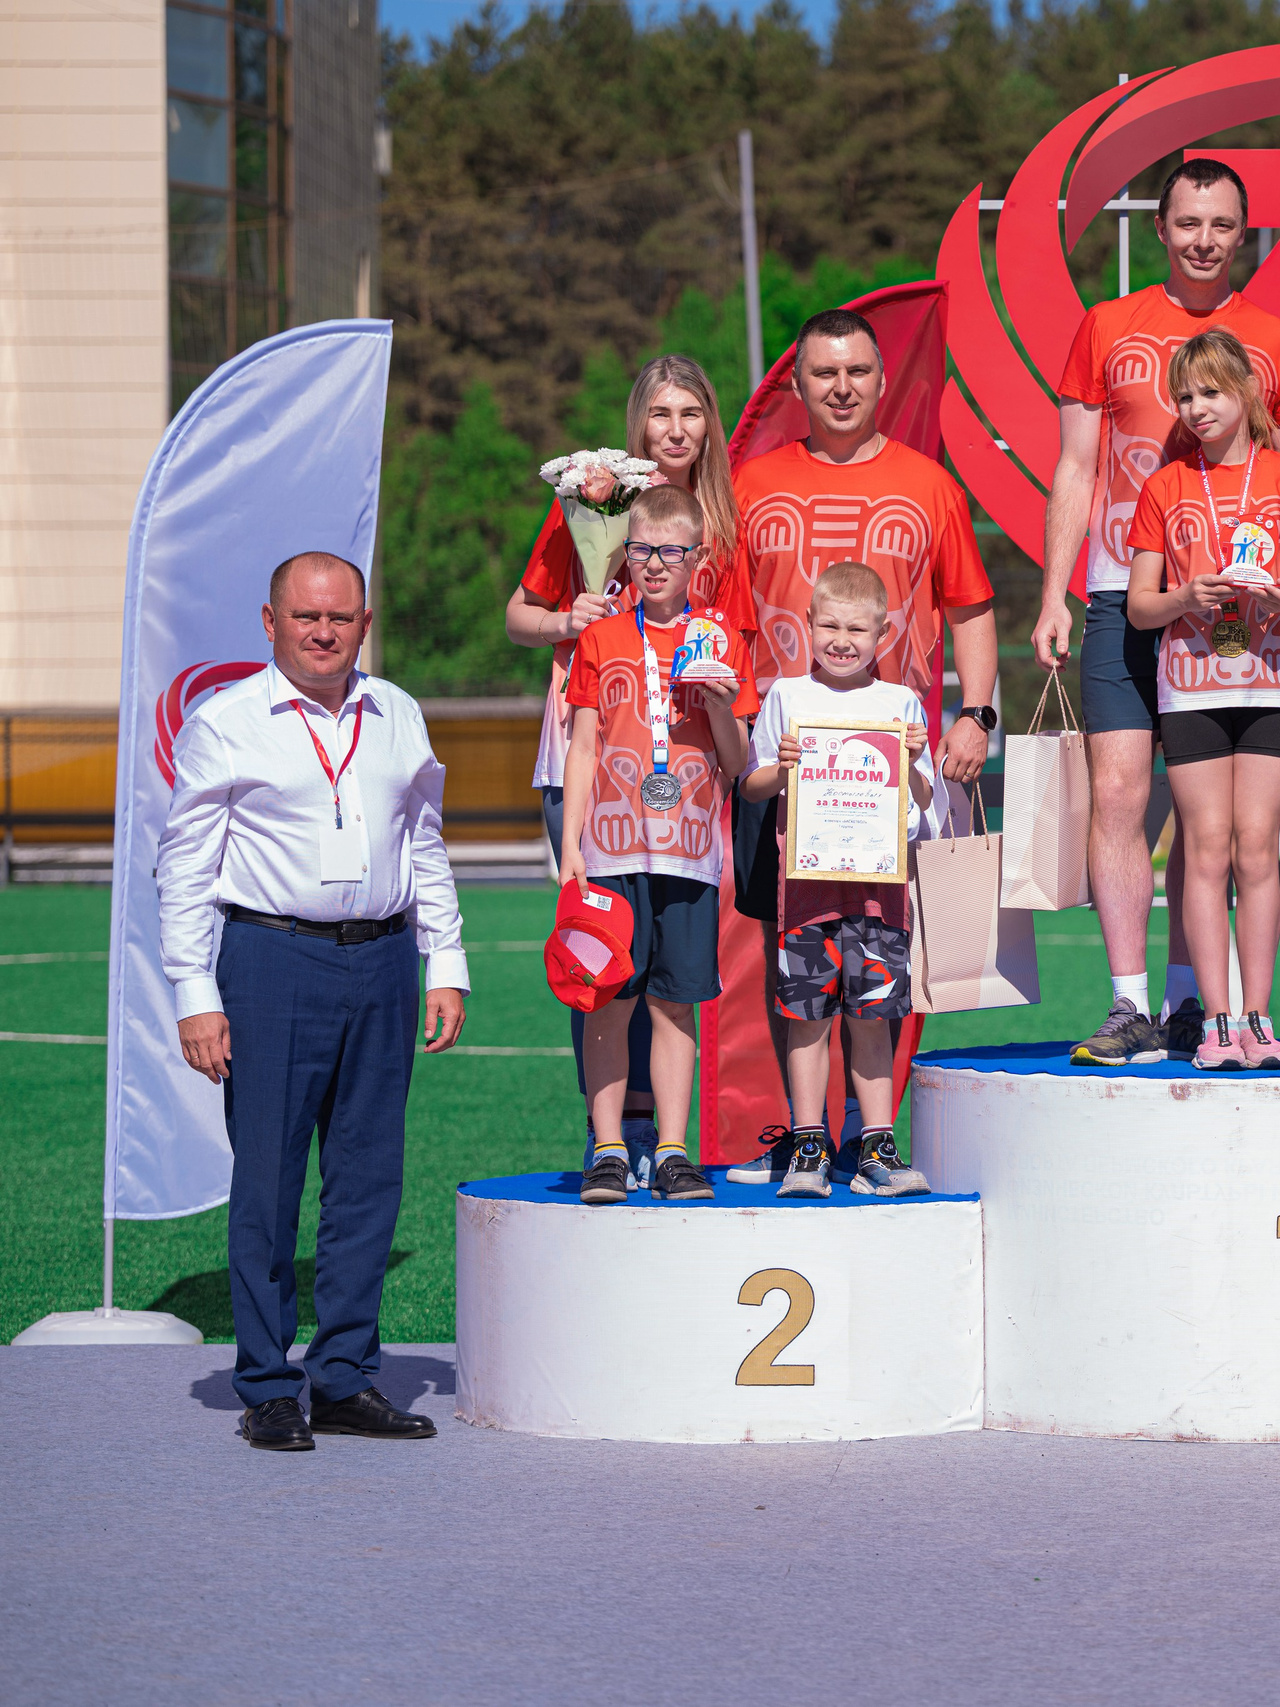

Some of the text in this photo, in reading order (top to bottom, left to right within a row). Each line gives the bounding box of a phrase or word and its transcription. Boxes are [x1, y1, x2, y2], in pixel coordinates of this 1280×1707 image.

[801, 767, 884, 782] ДИПЛОМ
[816, 799, 876, 809] за 2 место
[737, 1268, 815, 1386] 2
